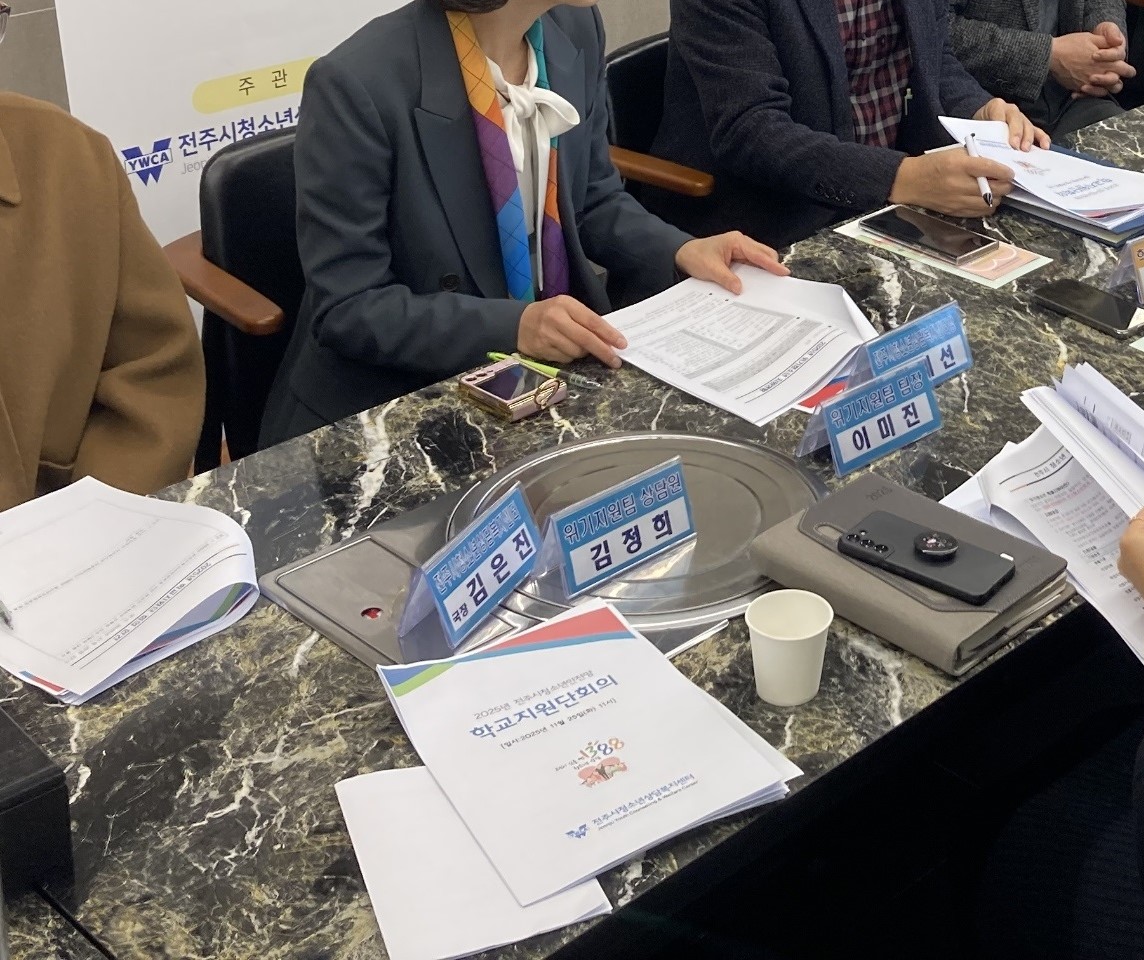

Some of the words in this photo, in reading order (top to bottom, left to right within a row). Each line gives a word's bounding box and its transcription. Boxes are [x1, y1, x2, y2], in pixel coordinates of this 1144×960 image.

[128, 150, 170, 171] YWCA
[830, 383, 896, 429] 위기지원팀
[897, 371, 924, 397] 팀장
[563, 493, 637, 545] 위기지원팀
[640, 471, 683, 508] 상담원
[452, 602, 469, 623] 국장
[469, 674, 619, 739] 학교지원단회의
[473, 702, 511, 720] 2025년
[579, 737, 625, 758] 1388
